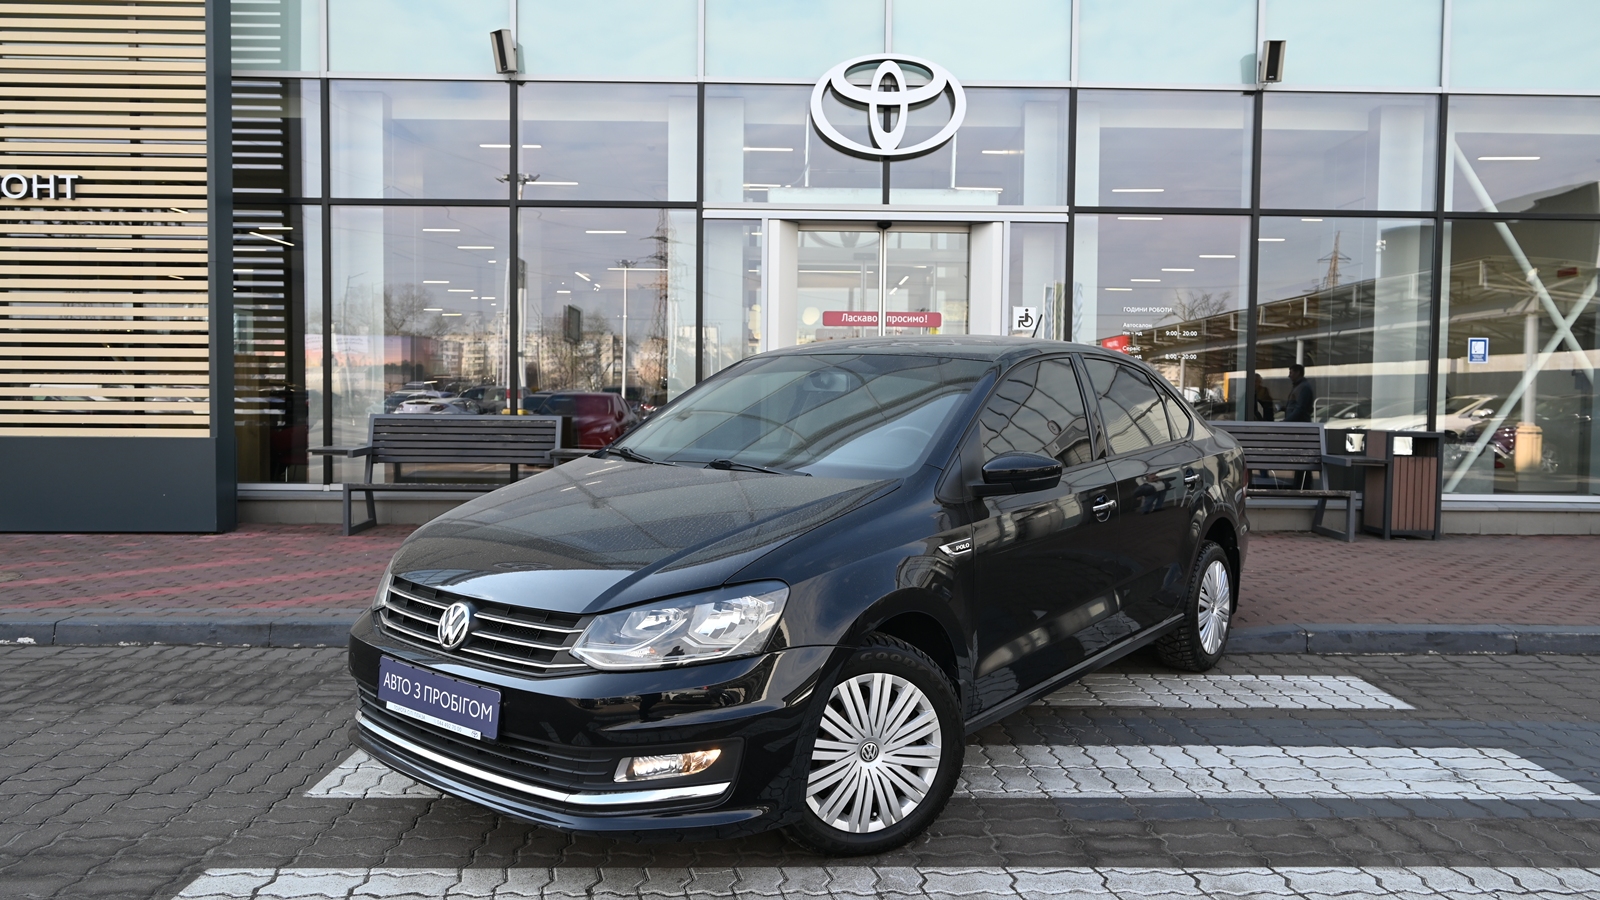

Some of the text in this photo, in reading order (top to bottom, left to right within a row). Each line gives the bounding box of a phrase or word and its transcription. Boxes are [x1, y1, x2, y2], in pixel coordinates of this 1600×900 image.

[841, 313, 928, 324] Ласкаво просимо!
[955, 542, 970, 551] POLO
[383, 671, 412, 695] АВТО
[423, 685, 493, 722] ПРОБІГОМ
